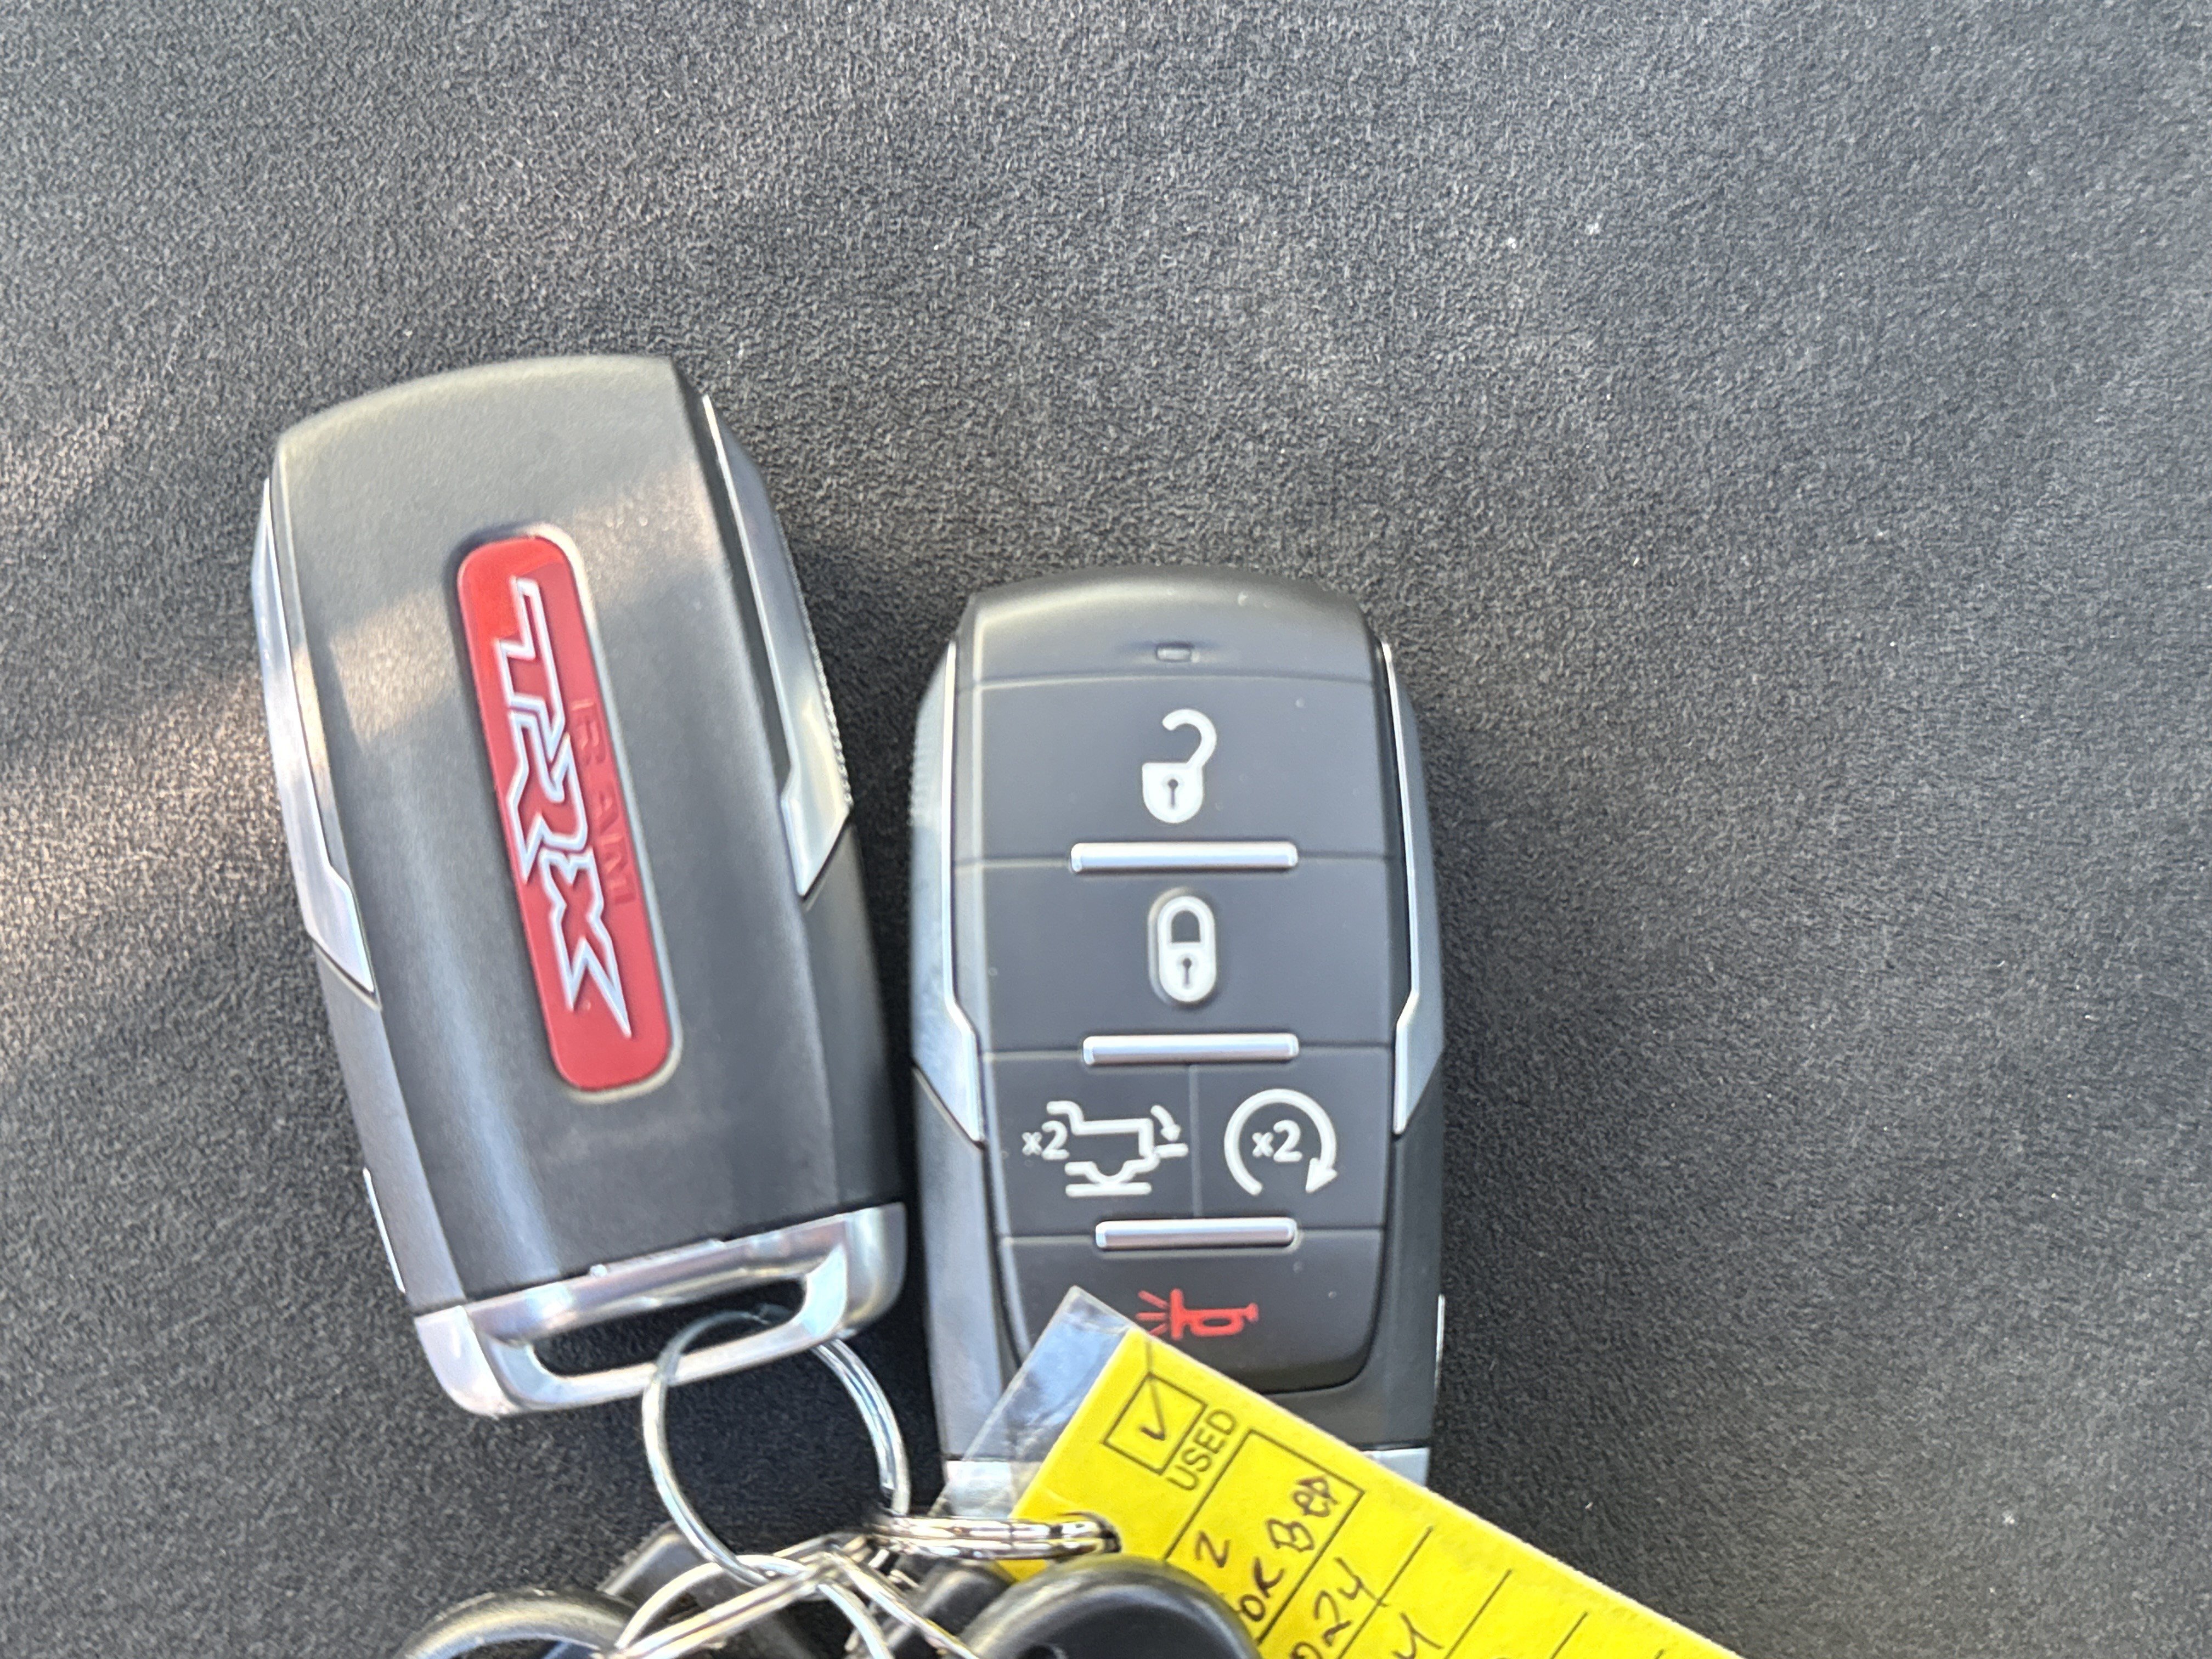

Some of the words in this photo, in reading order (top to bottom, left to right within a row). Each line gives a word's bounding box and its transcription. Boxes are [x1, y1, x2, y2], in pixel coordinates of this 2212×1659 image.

[494, 577, 631, 1037] TRX
[571, 699, 637, 905] RAM
[1022, 1120, 1069, 1160] x2
[1251, 1120, 1302, 1163] x2
[1164, 1408, 1239, 1491] USED
